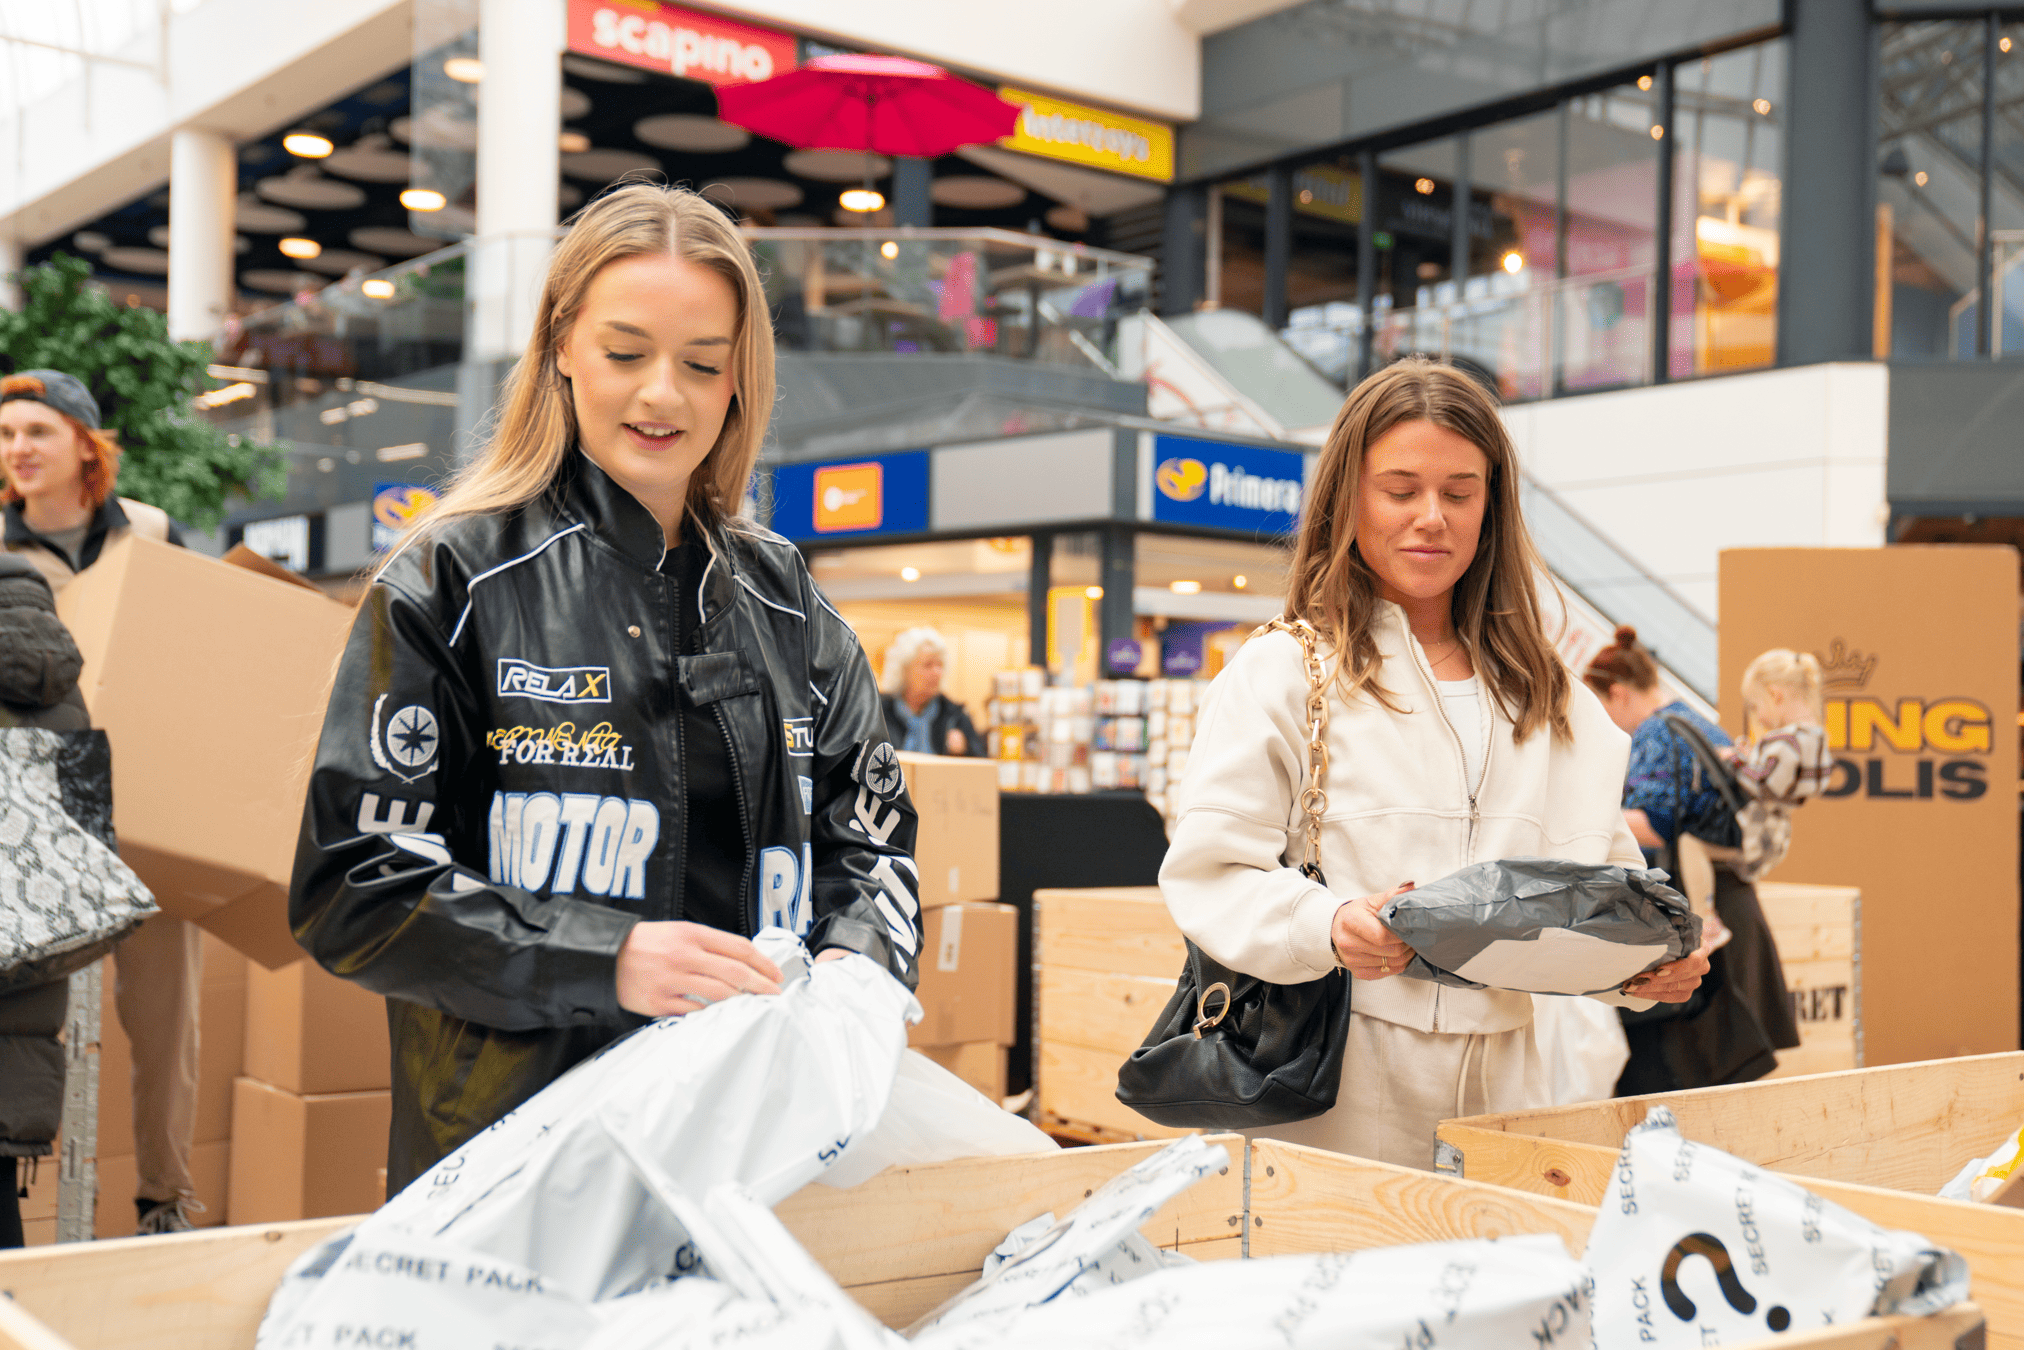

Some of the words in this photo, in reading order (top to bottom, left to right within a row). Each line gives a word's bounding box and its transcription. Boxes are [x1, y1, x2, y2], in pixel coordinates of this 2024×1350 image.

[592, 8, 774, 82] scapino
[1209, 461, 1301, 515] Primera
[502, 666, 607, 698] RELAX
[499, 739, 555, 765] FOR
[1825, 697, 1994, 754] ING
[1823, 758, 1988, 800] OLIS
[488, 790, 660, 900] MOTOR
[1734, 1186, 1769, 1276] SECRET
[465, 1264, 546, 1295] PACK
[1631, 1275, 1657, 1344] PACK
[333, 1324, 418, 1350] PACK
